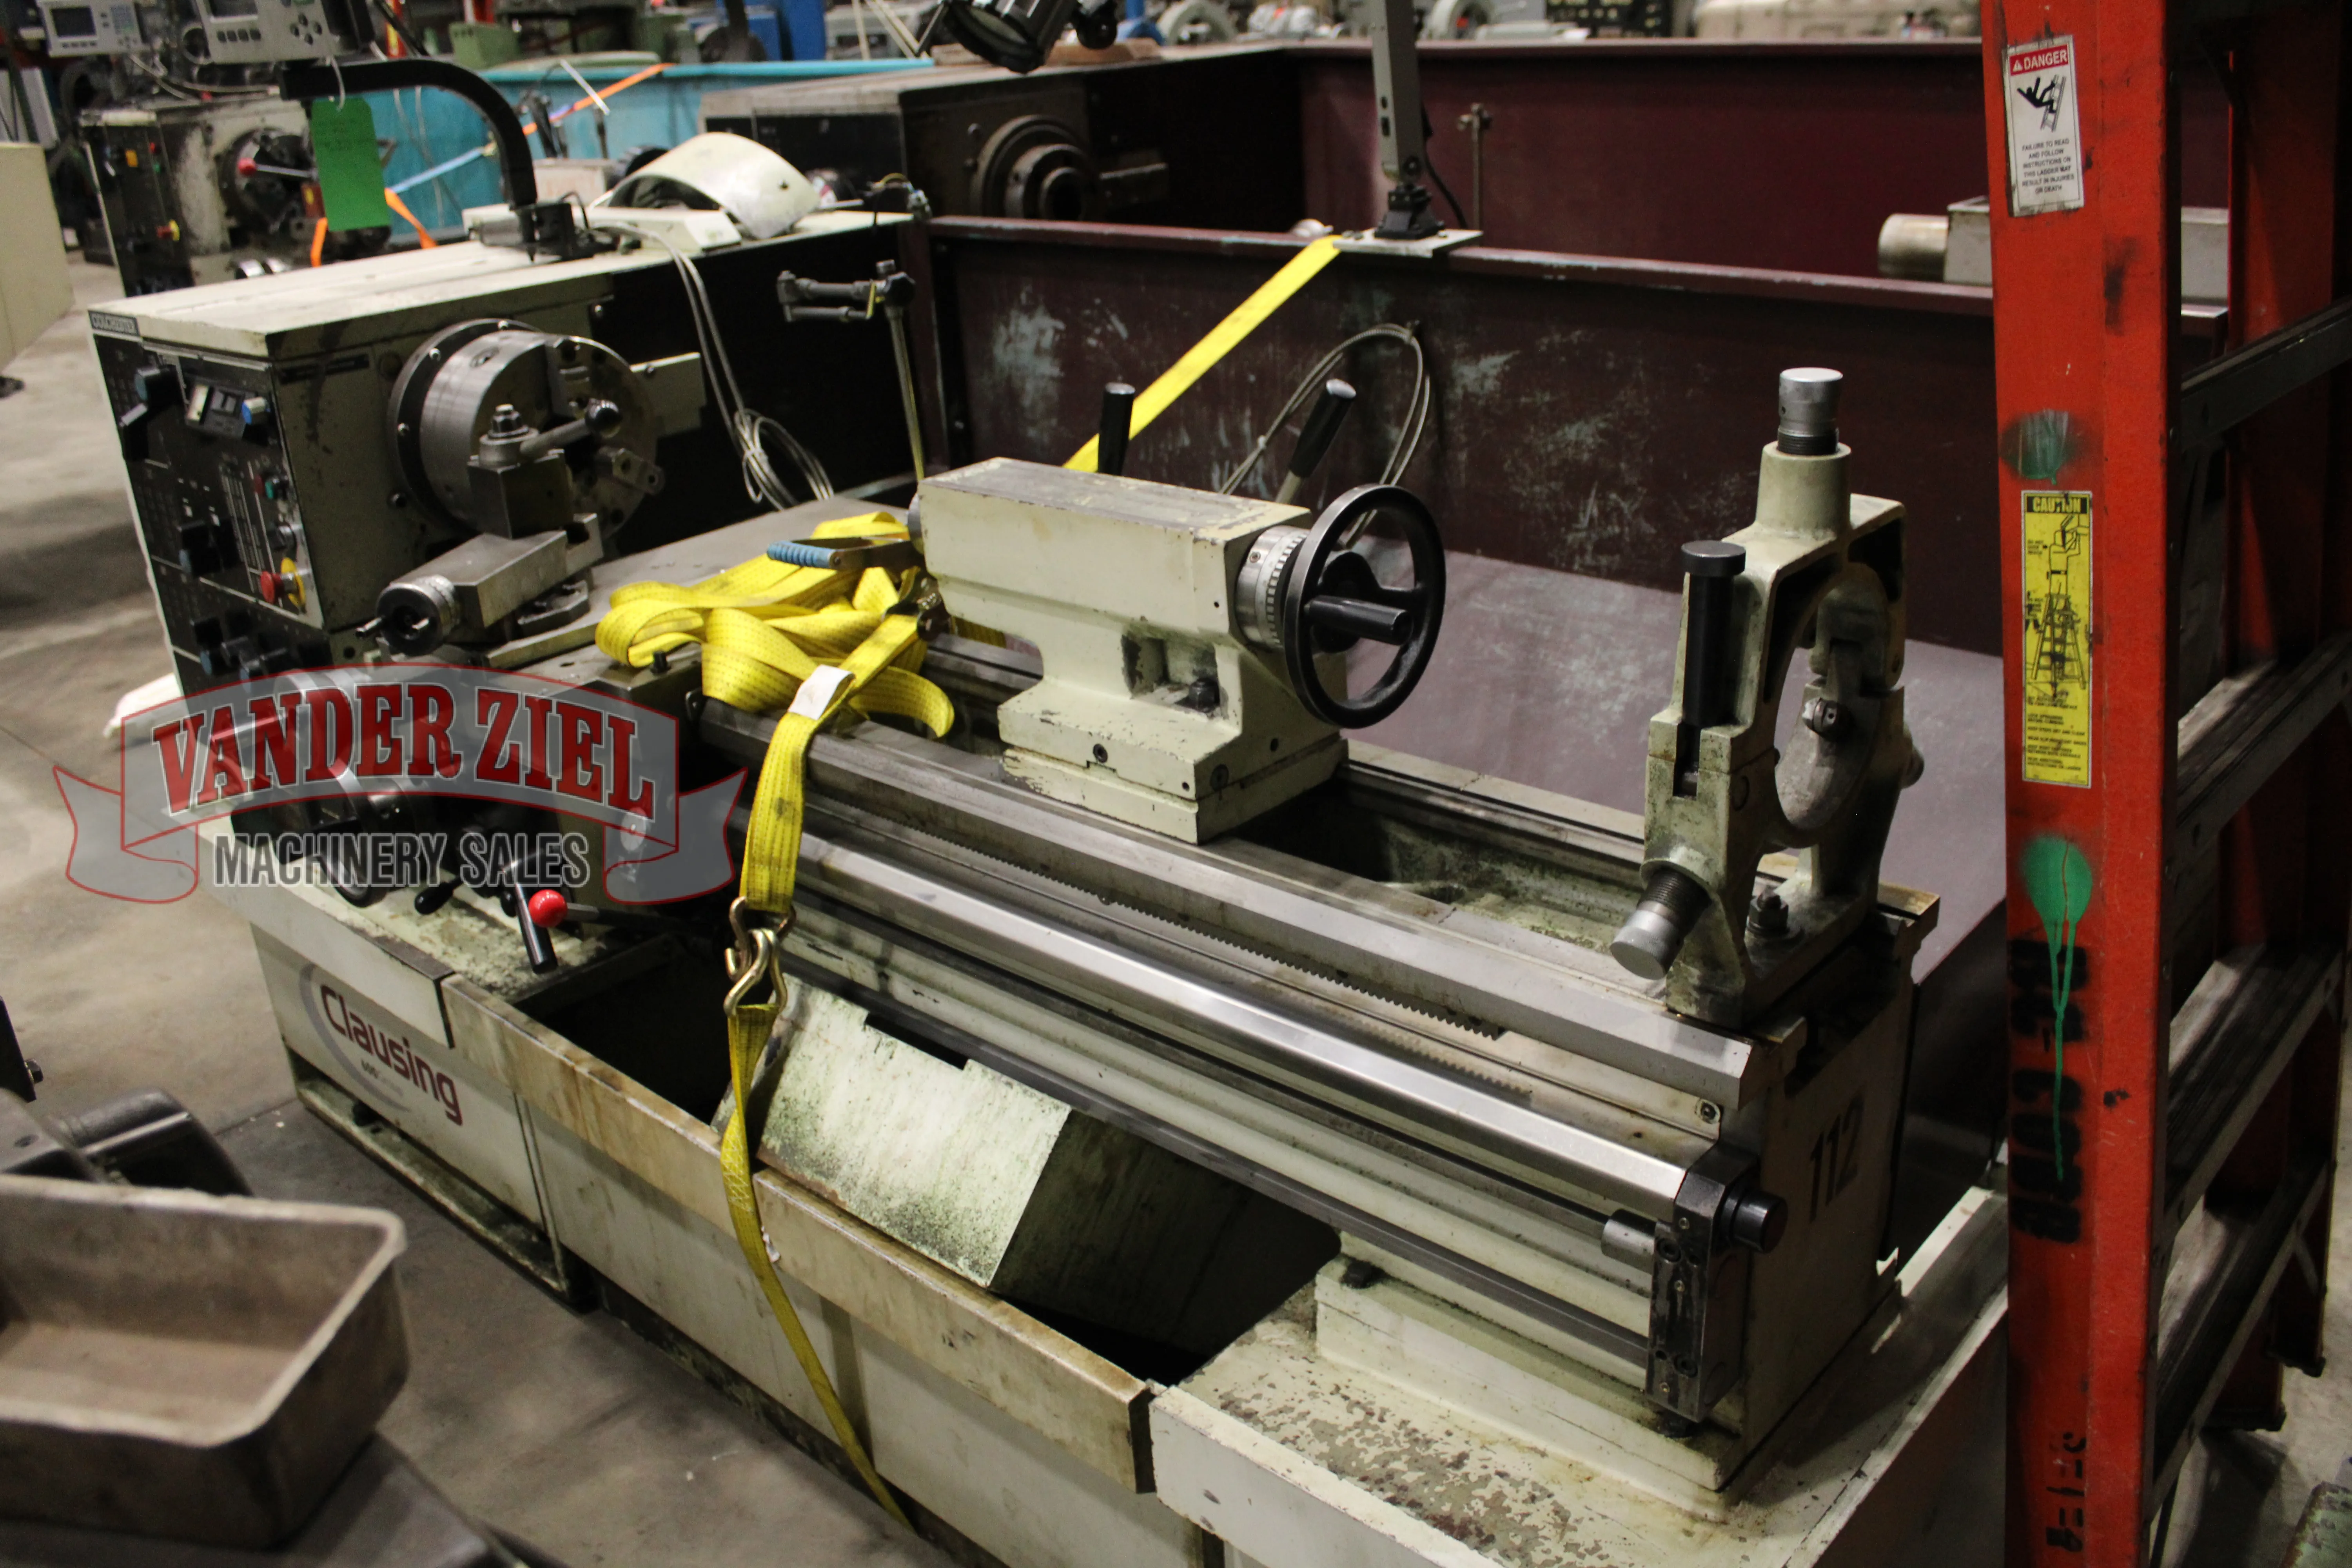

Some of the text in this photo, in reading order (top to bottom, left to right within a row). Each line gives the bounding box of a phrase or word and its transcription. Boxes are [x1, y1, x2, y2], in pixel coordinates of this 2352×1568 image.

[2024, 49, 2067, 71] DANGER
[2022, 142, 2044, 151] FAILURE
[2023, 158, 2062, 169] INSTRUCTIONS
[2037, 167, 2058, 176] LADDER
[319, 984, 463, 1126] Clausing
